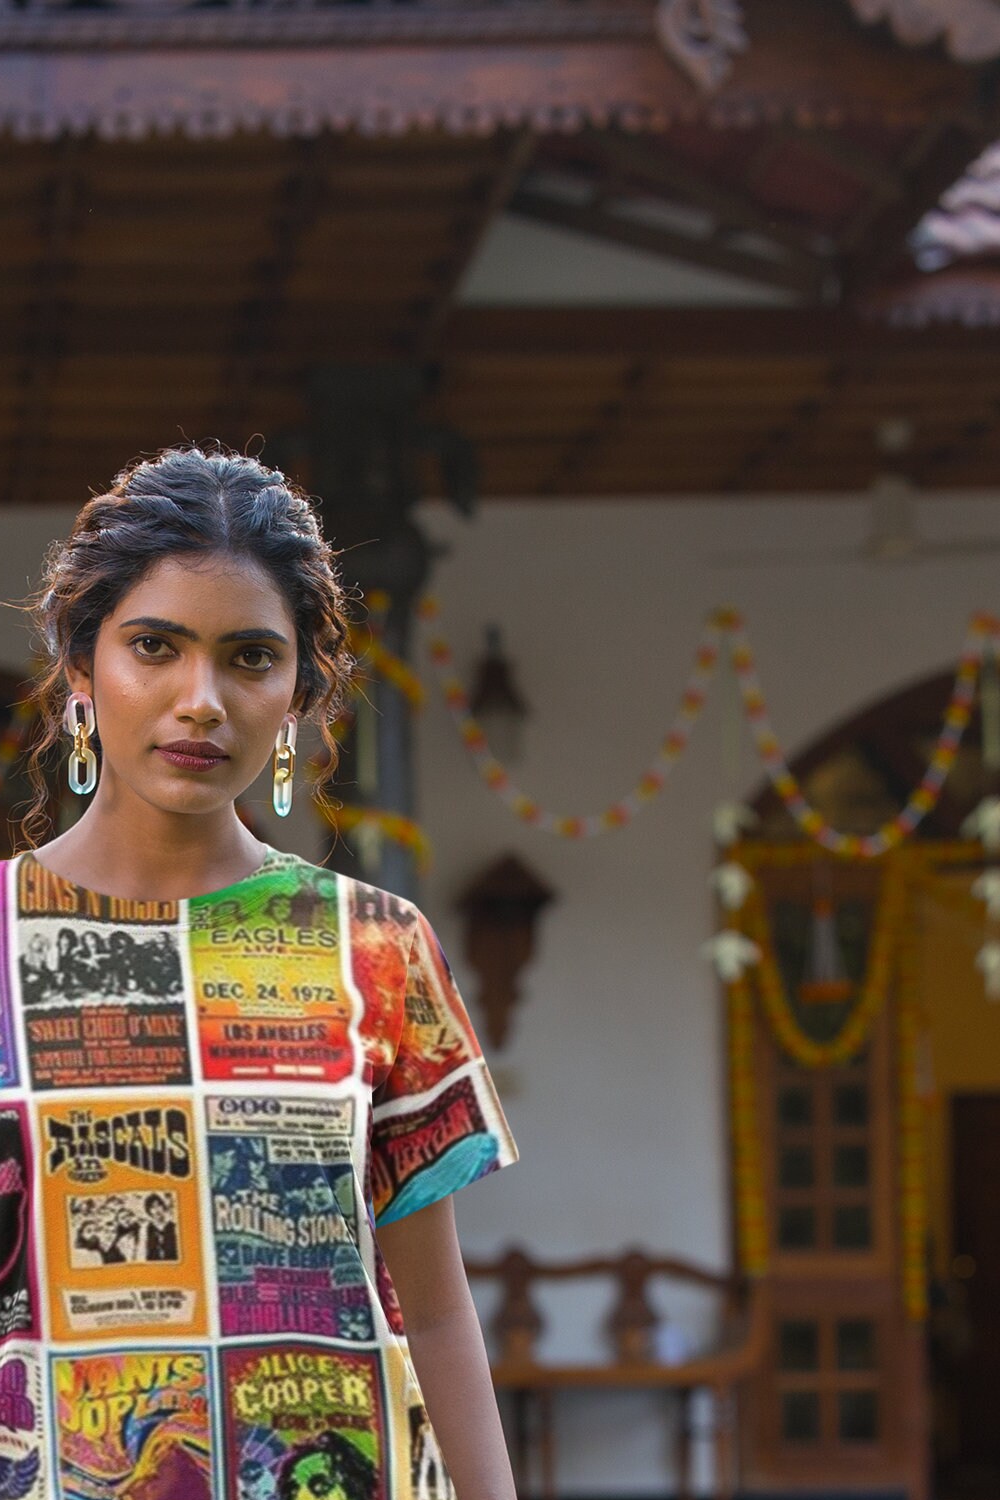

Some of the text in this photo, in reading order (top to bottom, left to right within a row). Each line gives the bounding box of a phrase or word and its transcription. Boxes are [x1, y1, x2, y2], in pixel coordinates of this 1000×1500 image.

[211, 928, 339, 947] EAGLES
[244, 945, 287, 954] LIVE
[203, 983, 249, 999] DEC.
[292, 987, 338, 1001] 1972
[223, 1023, 327, 1042] LOS ANGELES
[47, 1108, 191, 1179] RASCALS
[235, 1190, 281, 1211] THE
[214, 1194, 296, 1246] ROLLING
[54, 1354, 207, 1400] JANIS
[257, 1353, 335, 1377] ALICE
[235, 1375, 369, 1415] COOPER
[58, 1388, 208, 1440] JOPLIN
